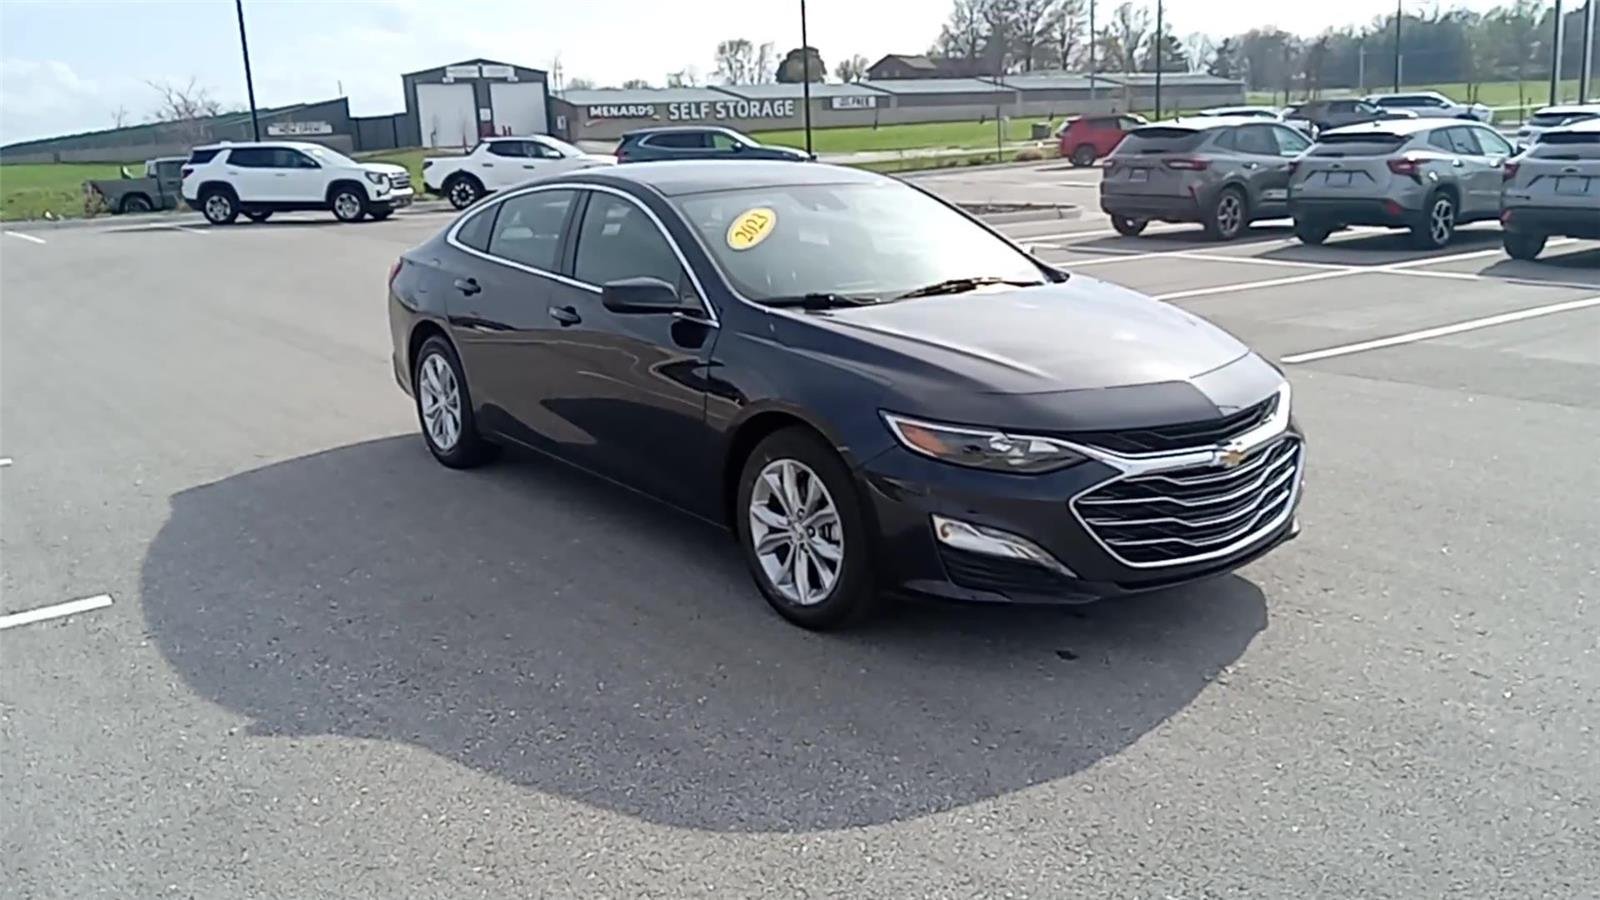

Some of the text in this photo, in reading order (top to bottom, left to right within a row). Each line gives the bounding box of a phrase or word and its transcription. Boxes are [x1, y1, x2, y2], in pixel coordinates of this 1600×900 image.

[589, 100, 794, 120] MENARDS SELF STORAGE
[734, 212, 769, 243] 2023
